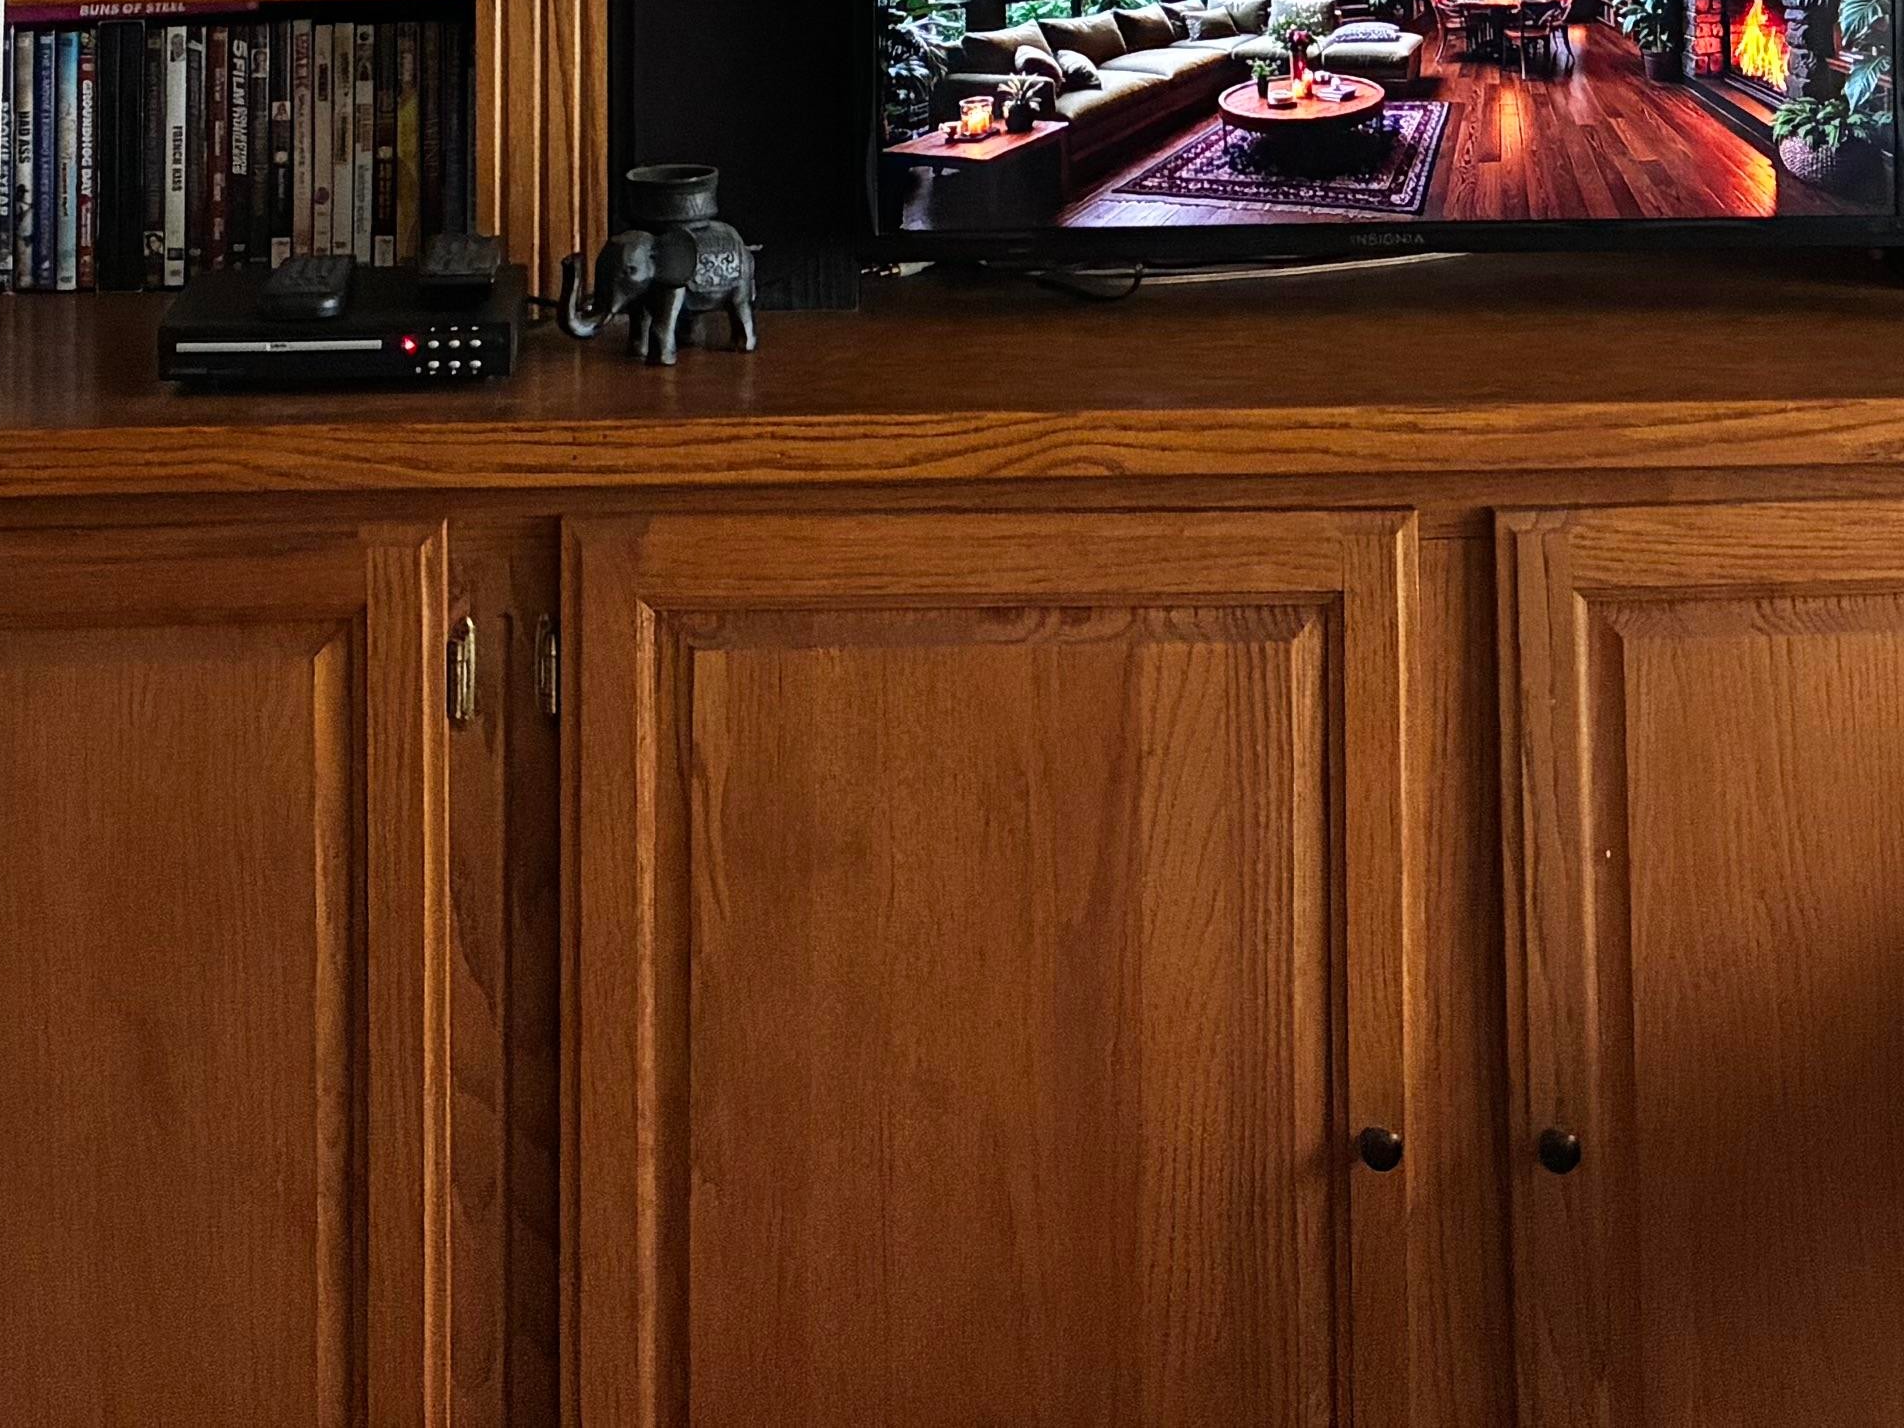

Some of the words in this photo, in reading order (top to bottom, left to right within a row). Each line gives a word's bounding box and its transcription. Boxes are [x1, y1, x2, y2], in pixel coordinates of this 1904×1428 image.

[81, 80, 92, 166] GROUNDHOG
[172, 126, 182, 165] FRENCH
[81, 169, 93, 196] DAY
[172, 168, 182, 192] KISS
